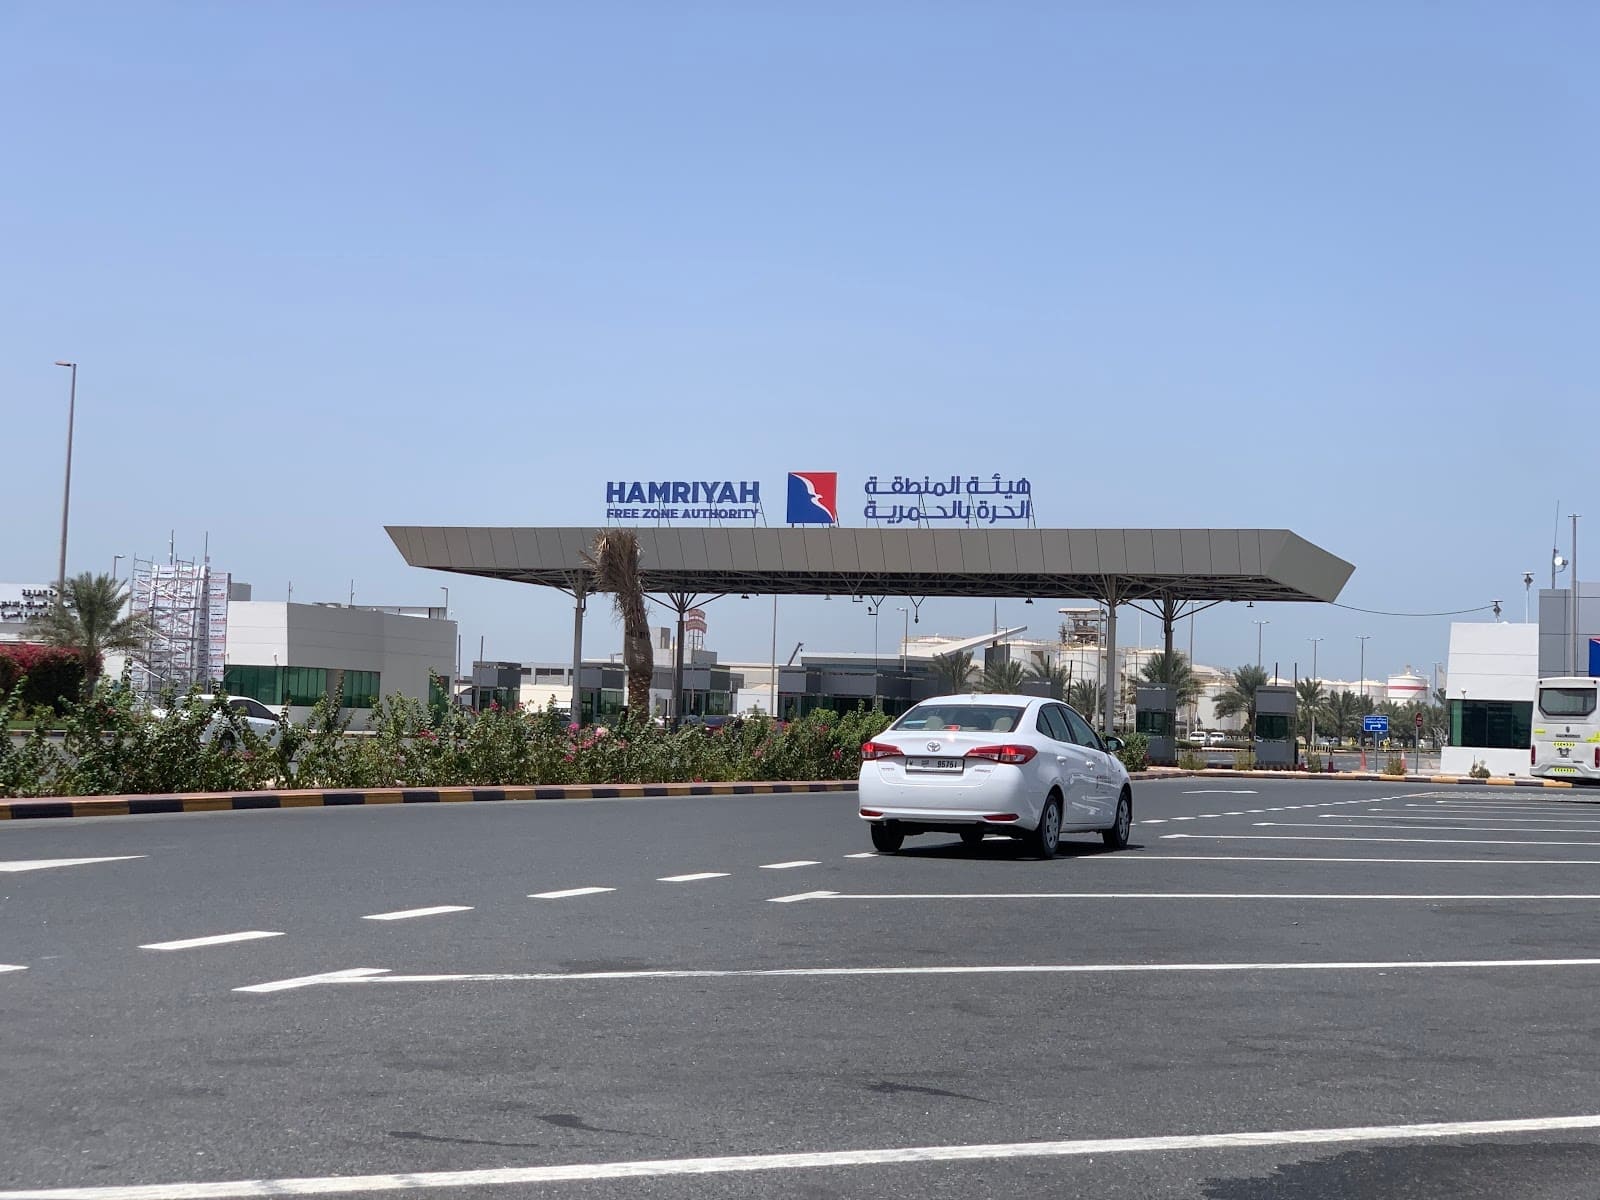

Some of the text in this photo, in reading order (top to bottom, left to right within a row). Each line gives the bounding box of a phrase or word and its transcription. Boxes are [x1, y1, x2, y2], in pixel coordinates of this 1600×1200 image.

[606, 481, 760, 503] HAMRIYAH
[864, 473, 1031, 499] هيئة المنطقة
[606, 508, 760, 518] FREE ZONE AUTHORITY
[863, 500, 1031, 524] الحرة بالحمرية
